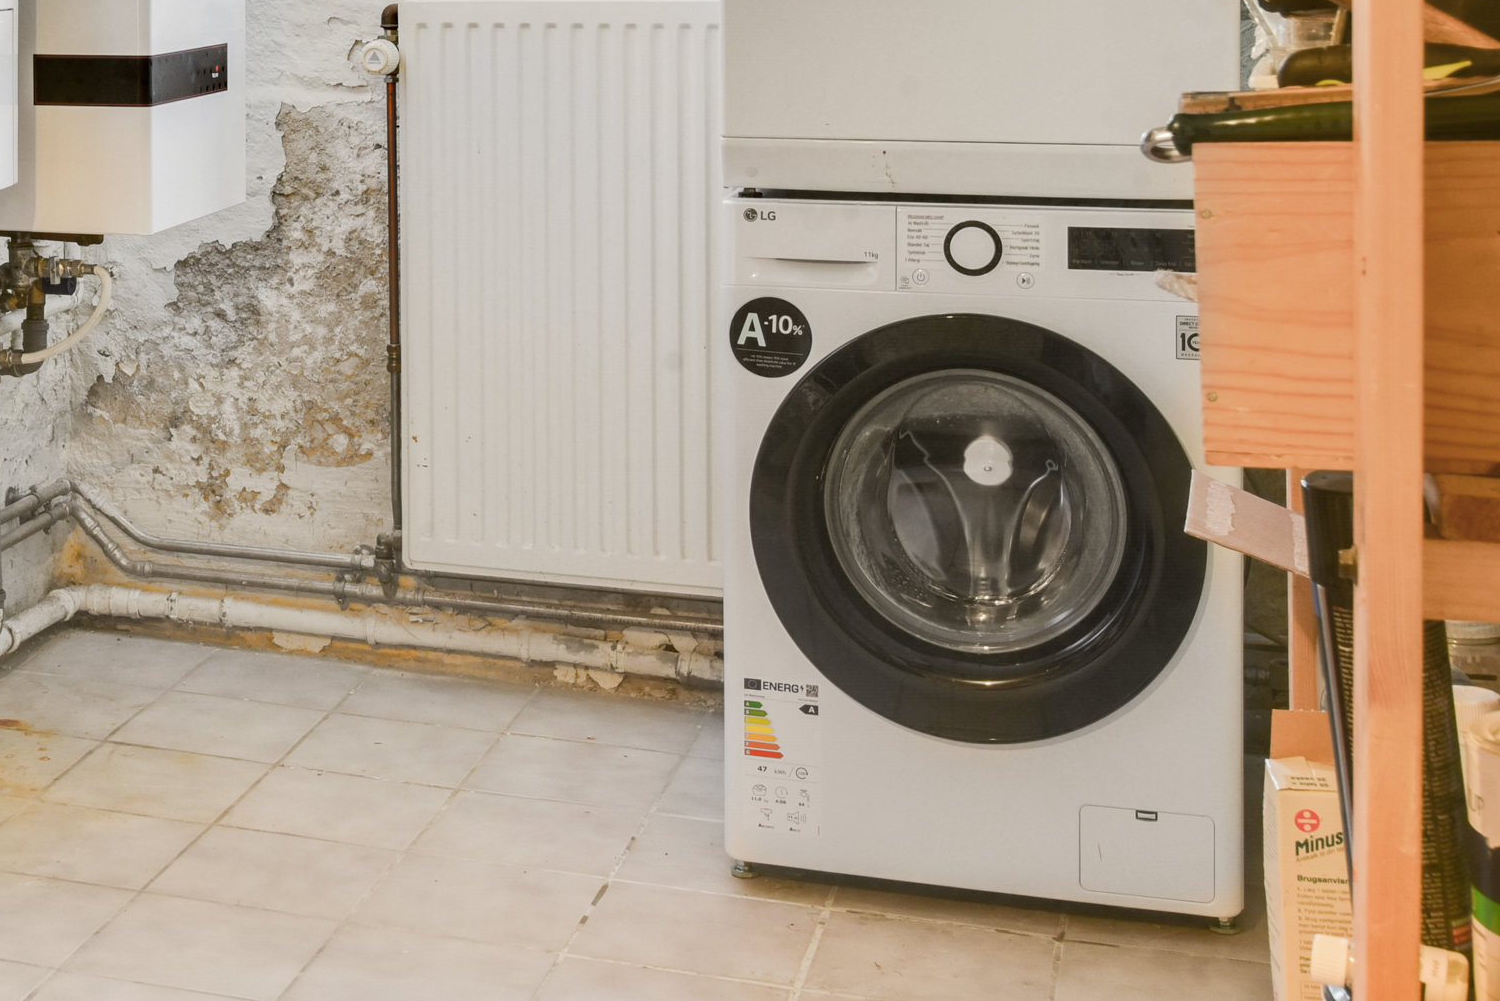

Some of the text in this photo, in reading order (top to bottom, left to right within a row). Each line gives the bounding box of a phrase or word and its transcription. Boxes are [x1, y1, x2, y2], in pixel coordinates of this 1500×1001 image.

[760, 211, 777, 221] LG
[737, 312, 767, 347] A
[762, 681, 799, 693] ENERG
[1295, 832, 1343, 856] Minus
